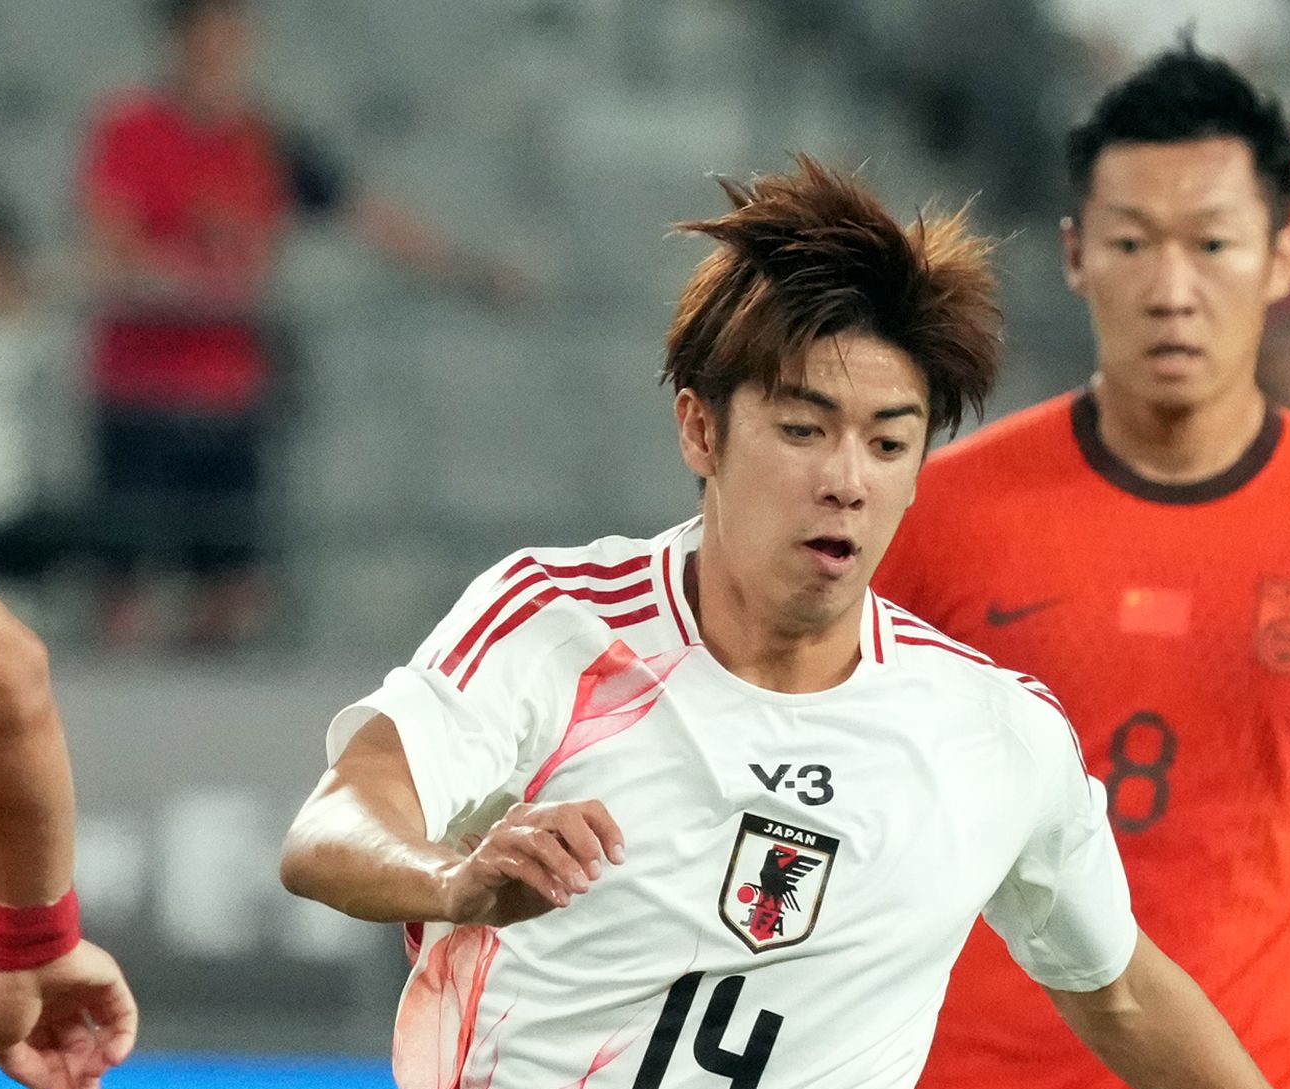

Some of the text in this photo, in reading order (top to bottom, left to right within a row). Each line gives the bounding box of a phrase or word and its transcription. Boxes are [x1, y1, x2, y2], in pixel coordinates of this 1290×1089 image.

[748, 763, 836, 806] Y-3
[1107, 710, 1178, 834] 8
[763, 822, 817, 847] JAPAN
